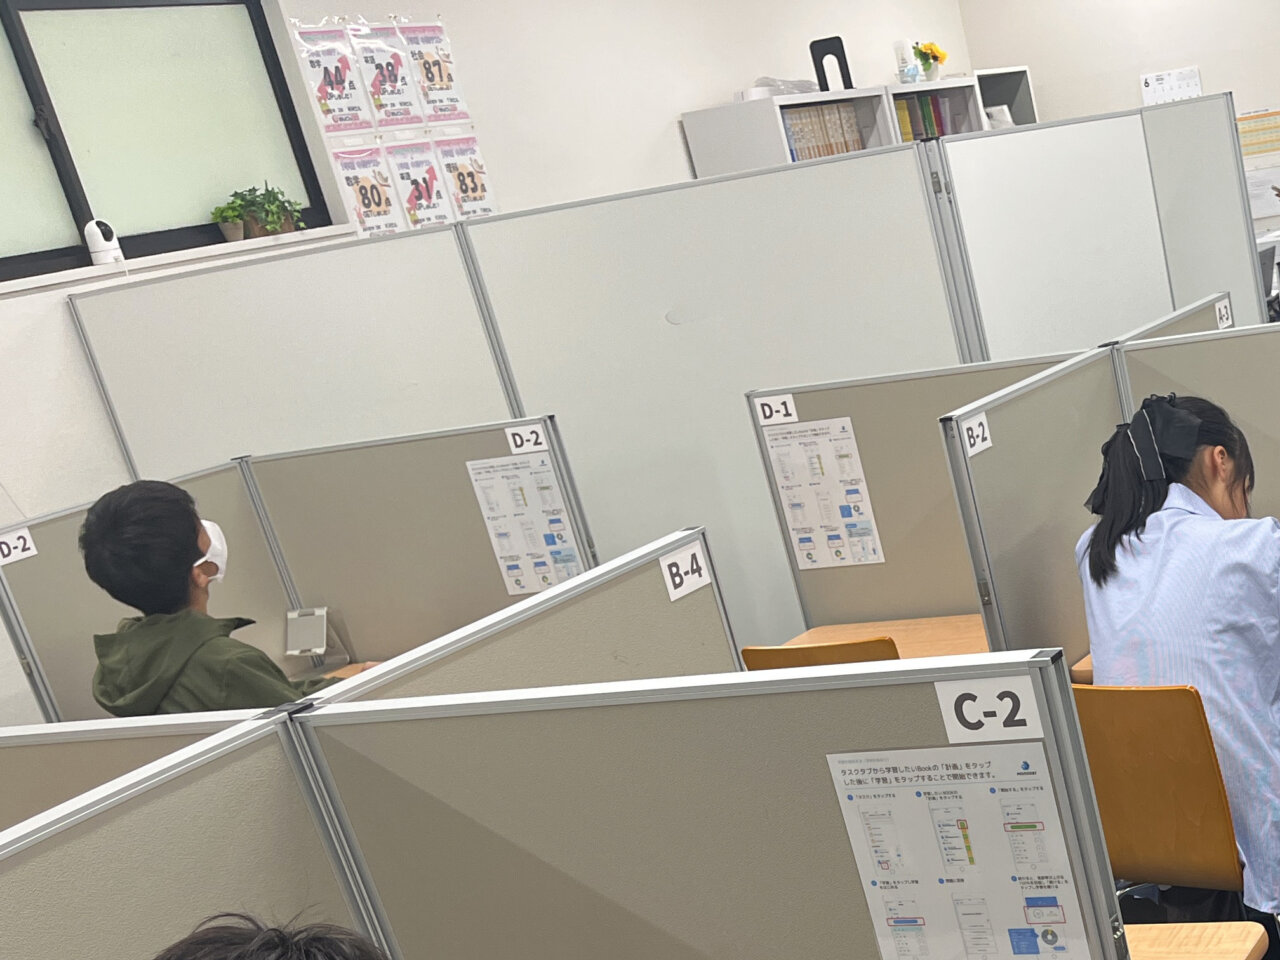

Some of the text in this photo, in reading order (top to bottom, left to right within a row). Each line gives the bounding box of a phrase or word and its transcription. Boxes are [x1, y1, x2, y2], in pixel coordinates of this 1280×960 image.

[1144, 78, 1150, 88] 6
[760, 400, 793, 420] D-1
[511, 430, 543, 449] D-2
[966, 421, 988, 449] B-2
[0, 535, 31, 559] D-2
[667, 552, 703, 591] B-4
[954, 690, 1028, 731] C-2
